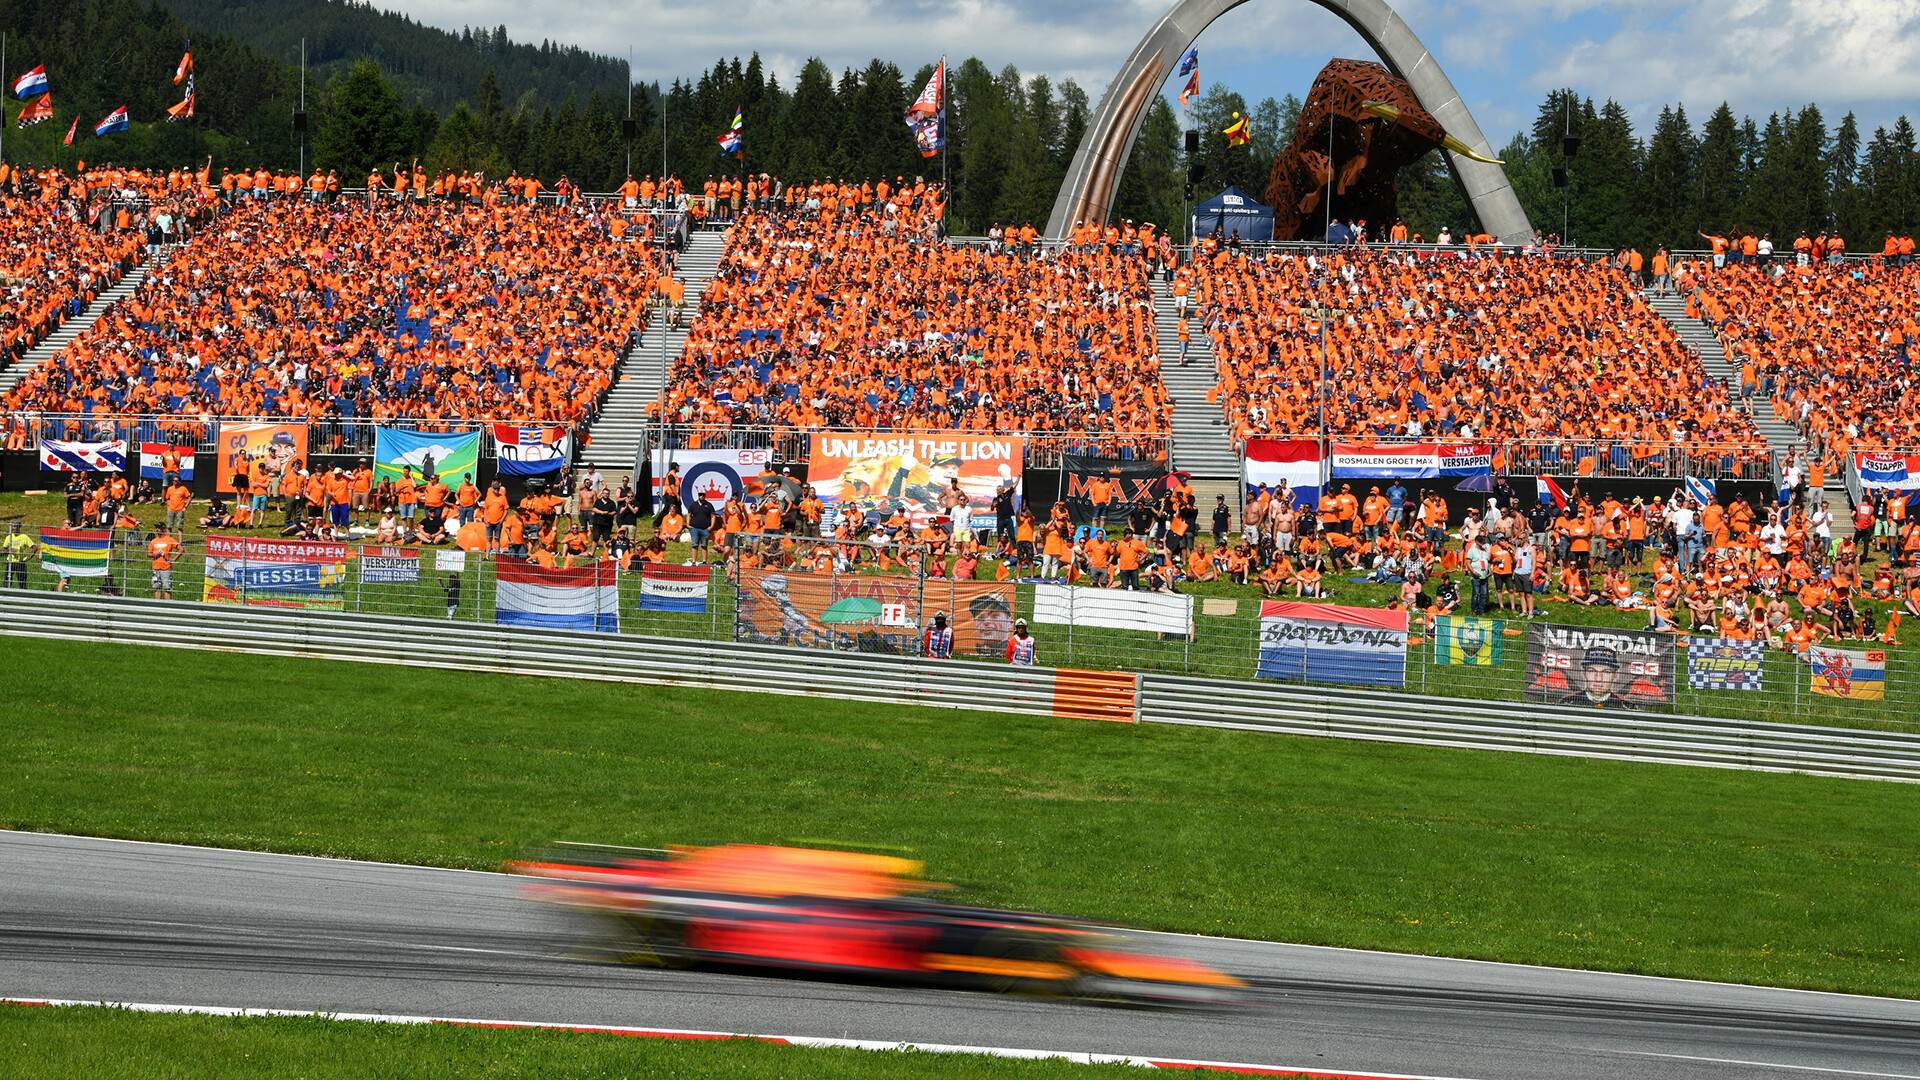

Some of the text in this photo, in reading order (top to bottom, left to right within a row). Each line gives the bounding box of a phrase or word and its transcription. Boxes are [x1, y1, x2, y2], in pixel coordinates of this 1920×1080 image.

[230, 434, 248, 450] GO
[821, 437, 1012, 460] UNLEASH THE LION
[739, 450, 768, 465] 33
[1455, 446, 1475, 456] MAX
[1338, 457, 1433, 465] ROSMALEN GROET MAX
[1441, 455, 1490, 468] VERSTAPPEN
[1066, 471, 1158, 503] MAX
[210, 540, 345, 558] MAX VERSTAPPEN
[381, 546, 401, 557] MAX
[364, 557, 418, 570] VERSTAPPEN
[653, 584, 693, 593] HOLLAND
[830, 578, 920, 612] MAX
[1541, 651, 1572, 669] 33
[1694, 657, 1760, 672] MEAS
[1867, 652, 1884, 662] 33
[1628, 660, 1661, 677] 33
